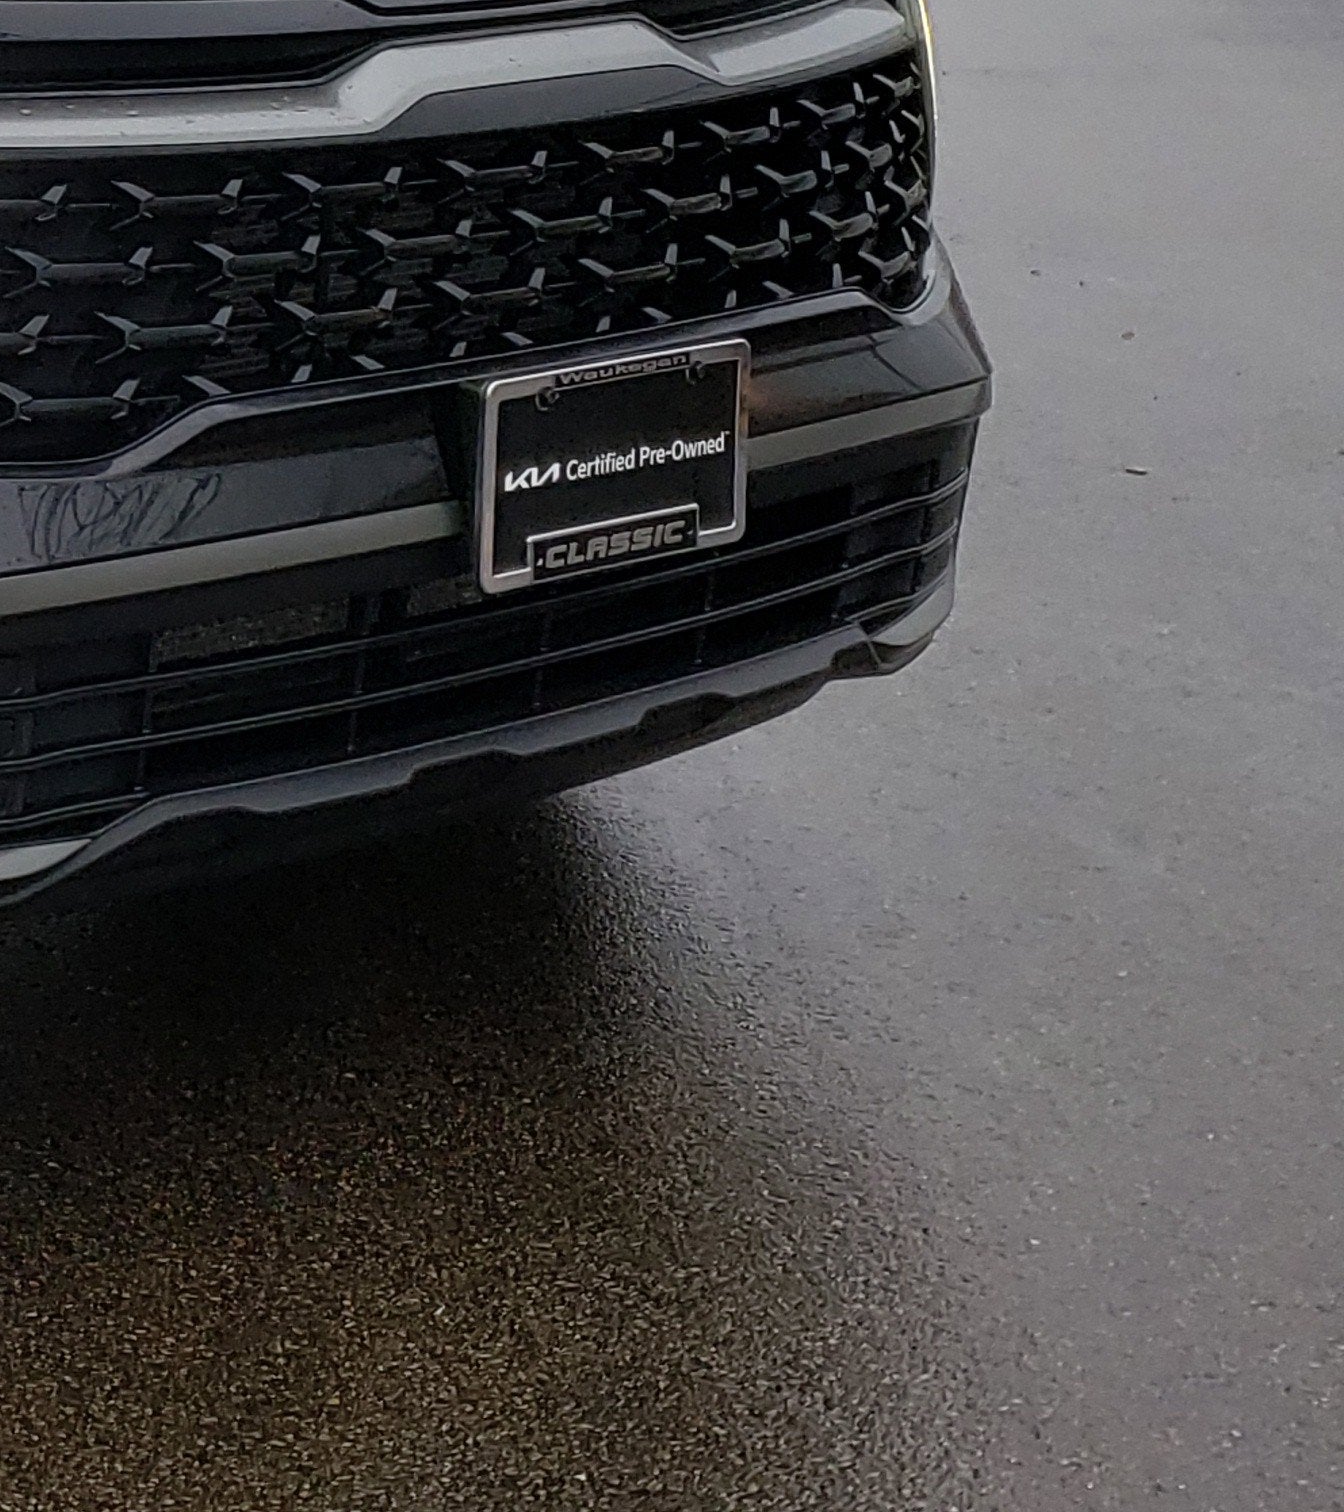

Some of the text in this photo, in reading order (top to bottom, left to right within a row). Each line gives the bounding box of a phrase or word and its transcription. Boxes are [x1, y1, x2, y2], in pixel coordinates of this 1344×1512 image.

[561, 354, 687, 384] Waukegan
[504, 462, 561, 492] KIA
[566, 448, 636, 481] Certified
[545, 520, 686, 569] CLASSIC
